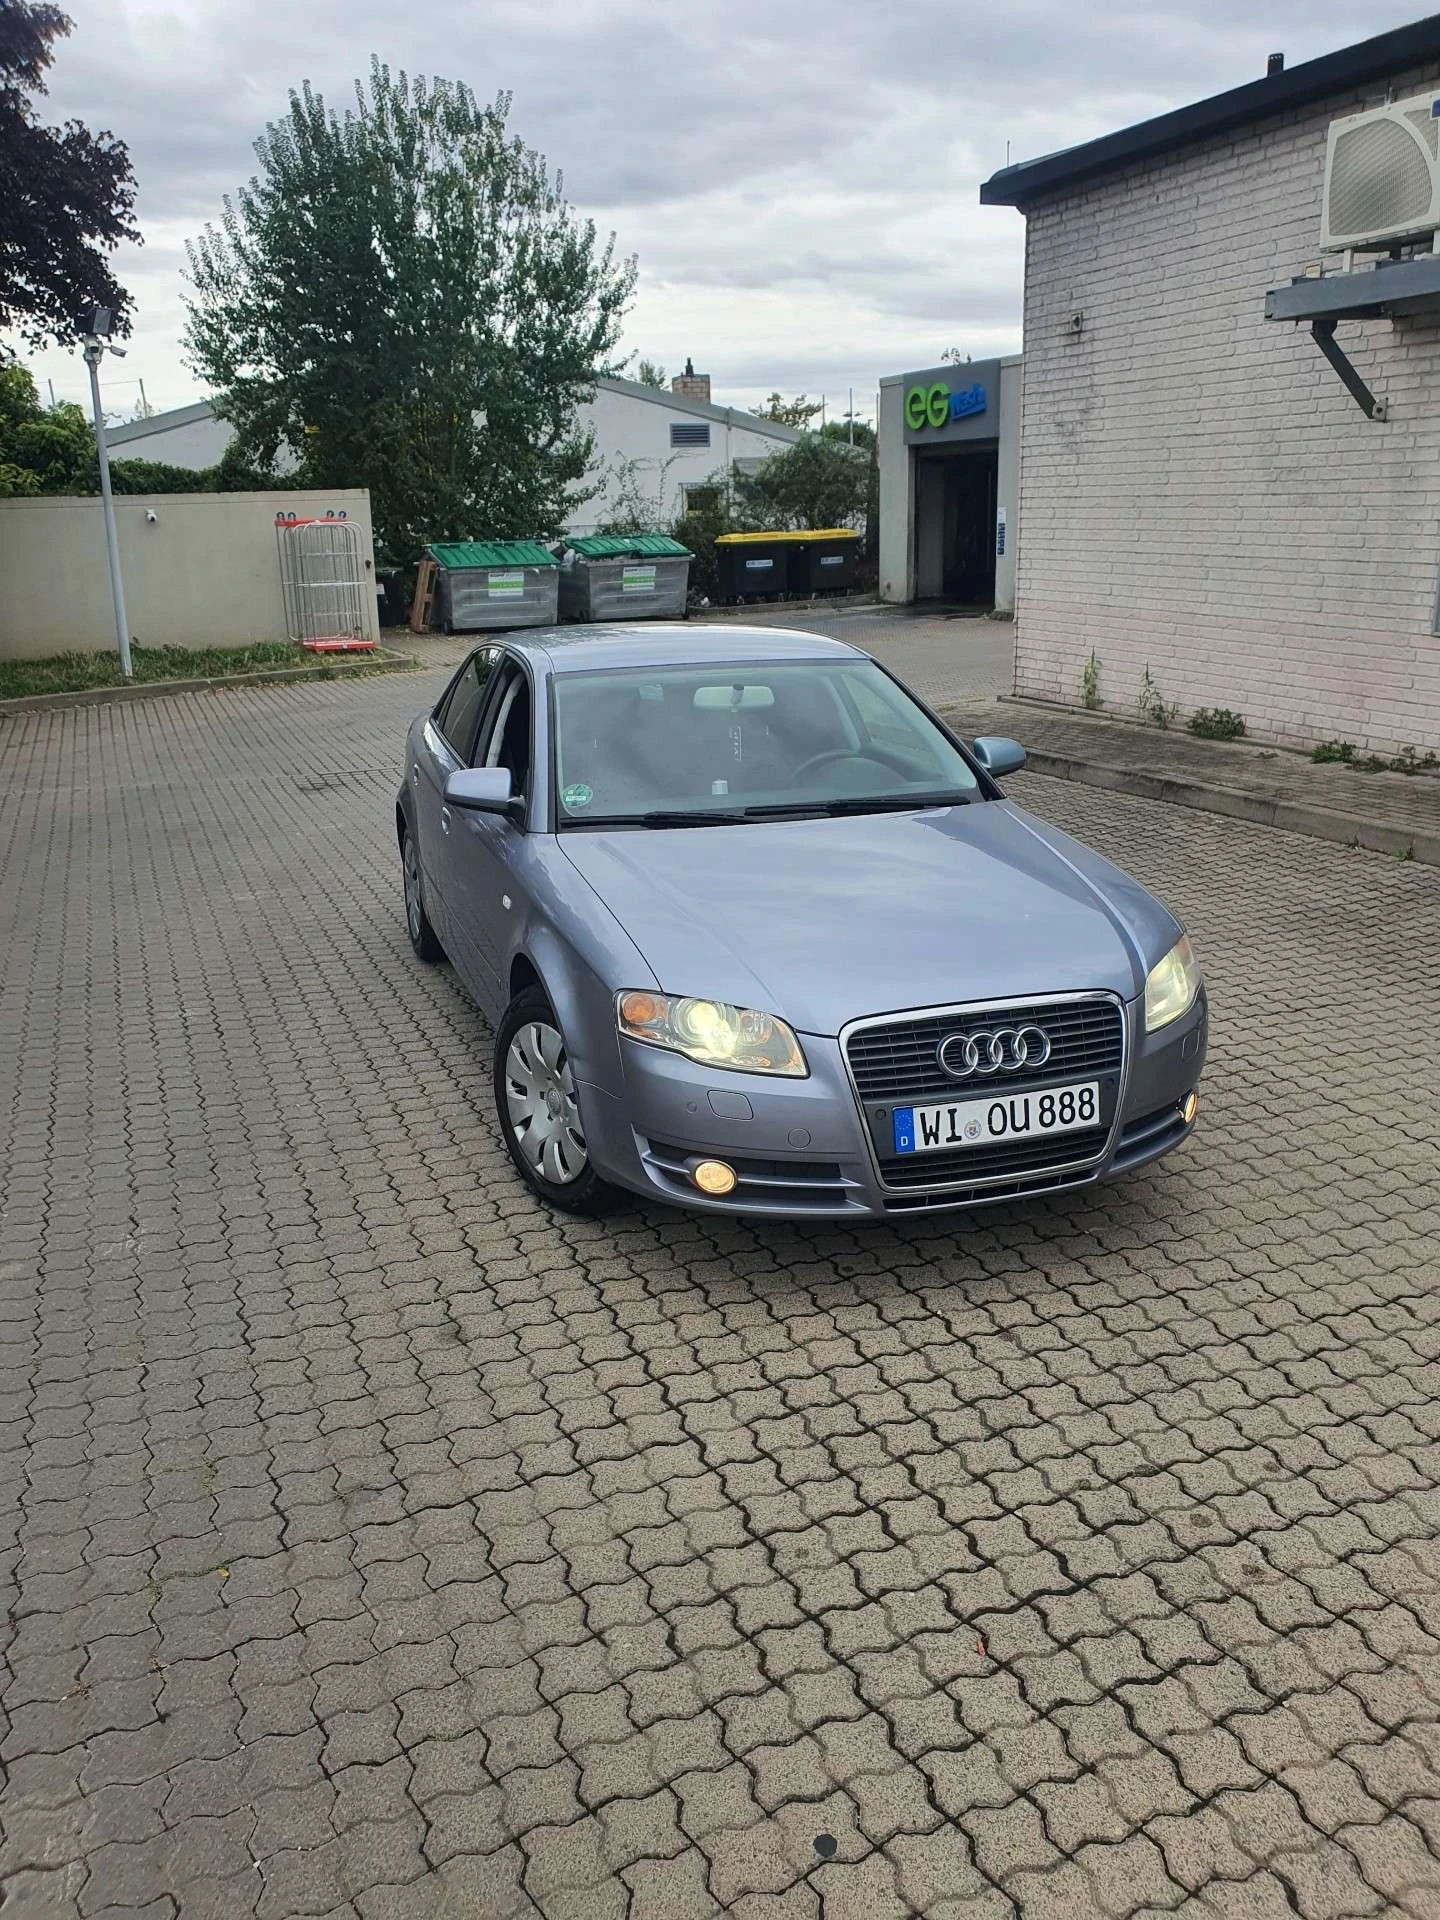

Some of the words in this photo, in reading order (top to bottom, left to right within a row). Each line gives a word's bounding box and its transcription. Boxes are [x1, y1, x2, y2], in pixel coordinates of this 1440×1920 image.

[919, 1107, 962, 1146] WI
[987, 1098, 1030, 1136] OU
[1038, 1087, 1095, 1128] 888
[900, 1135, 909, 1147] D
